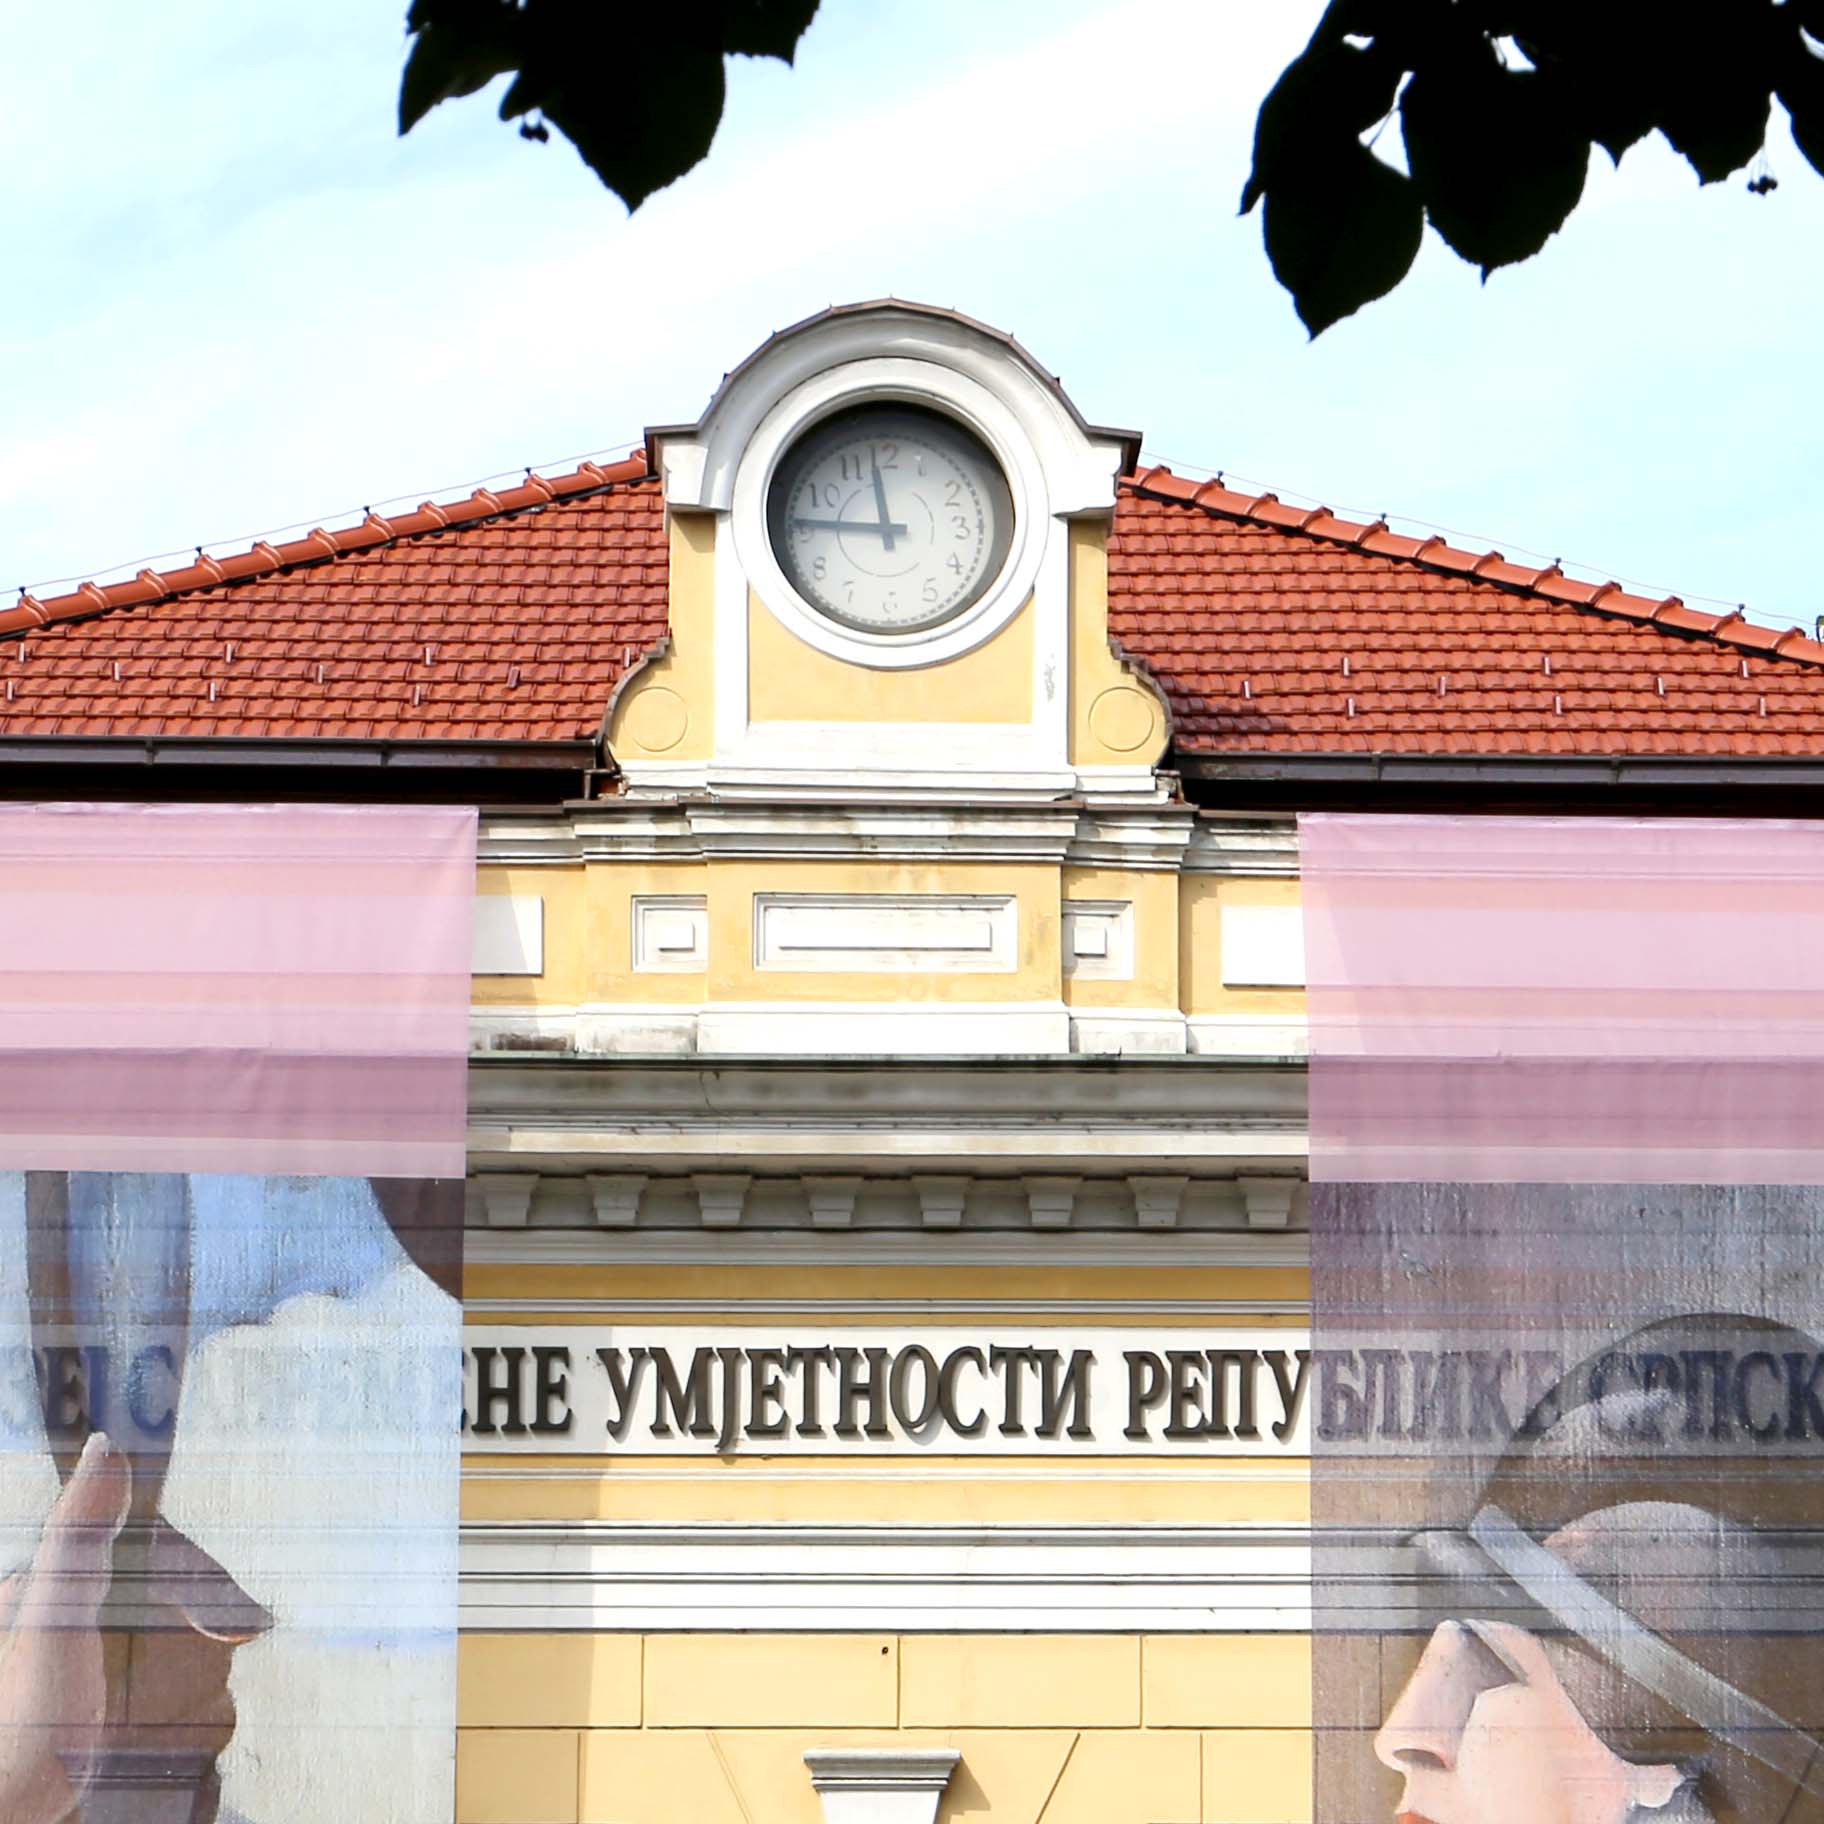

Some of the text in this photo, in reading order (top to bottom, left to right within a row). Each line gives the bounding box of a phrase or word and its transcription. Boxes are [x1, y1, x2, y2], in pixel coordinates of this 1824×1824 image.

[943, 480, 962, 508] 2
[951, 515, 972, 541] 3
[596, 1343, 1094, 1453] УМЈЕТНОСТИ
[1122, 1349, 1567, 1443] РЕПУБЛИКЕ
